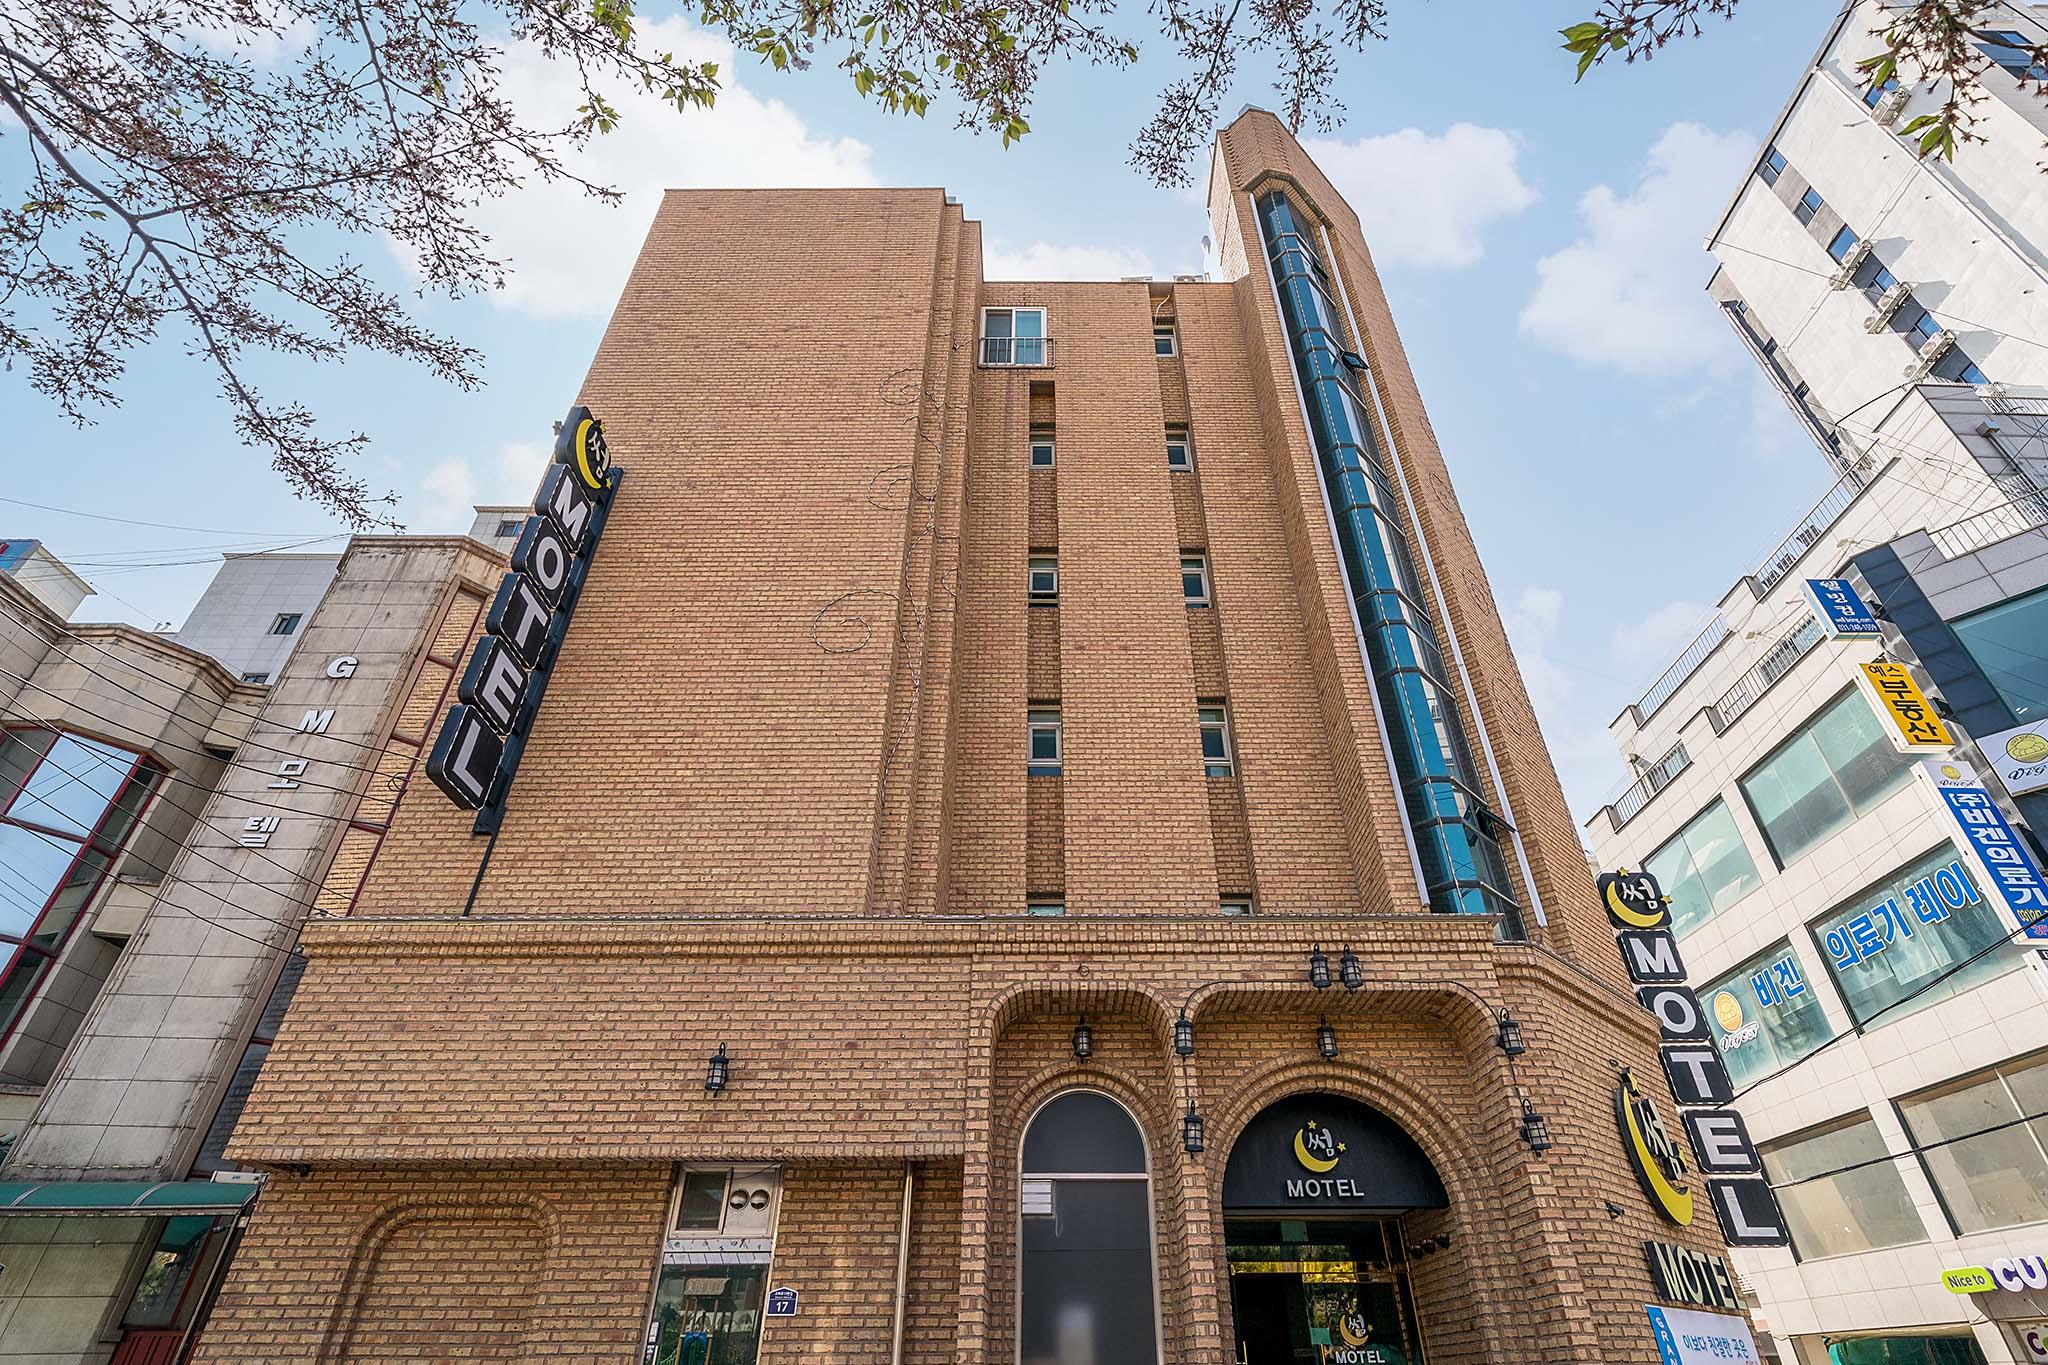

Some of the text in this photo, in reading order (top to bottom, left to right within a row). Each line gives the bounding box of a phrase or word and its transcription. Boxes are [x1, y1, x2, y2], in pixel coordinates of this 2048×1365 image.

[452, 475, 590, 798] MOTEL
[1868, 665, 1904, 677] 예스
[1878, 679, 1942, 743] 부동산
[1750, 860, 1984, 1008] 비겐 의료기 레이
[1636, 940, 1780, 1238] MOTEL
[1287, 1178, 1365, 1198] MOTEL
[1652, 1240, 1748, 1310] MOTEL
[1946, 1255, 2048, 1293] Nice to CU
[776, 1301, 789, 1313] 17
[1334, 1350, 1387, 1364] MOTEL
[1682, 1334, 1749, 1359] 이보다 친절한 곳은
